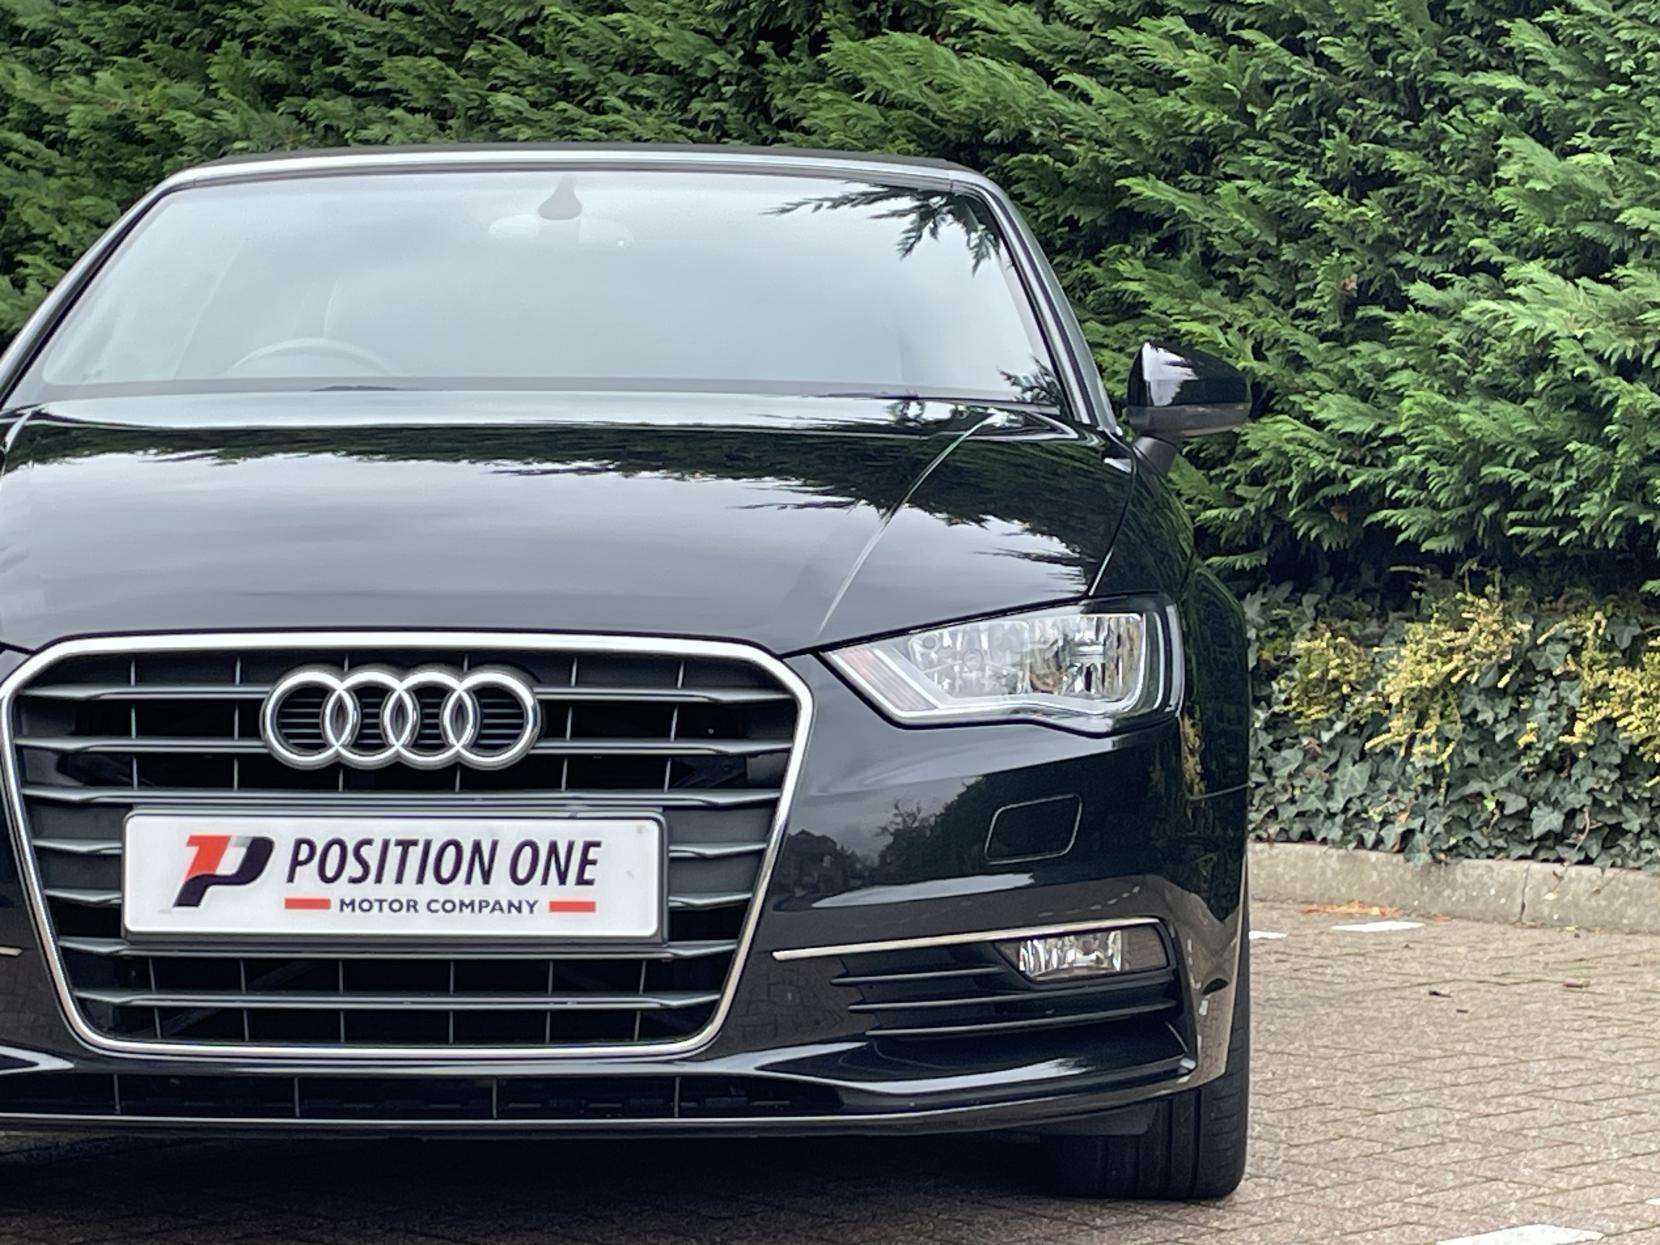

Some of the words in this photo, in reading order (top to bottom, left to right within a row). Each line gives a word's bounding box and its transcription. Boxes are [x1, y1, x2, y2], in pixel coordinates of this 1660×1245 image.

[286, 837, 499, 886] POSITION
[509, 839, 602, 886] ONE
[339, 898, 419, 914] MOTOR
[426, 899, 538, 914] COMPANY
